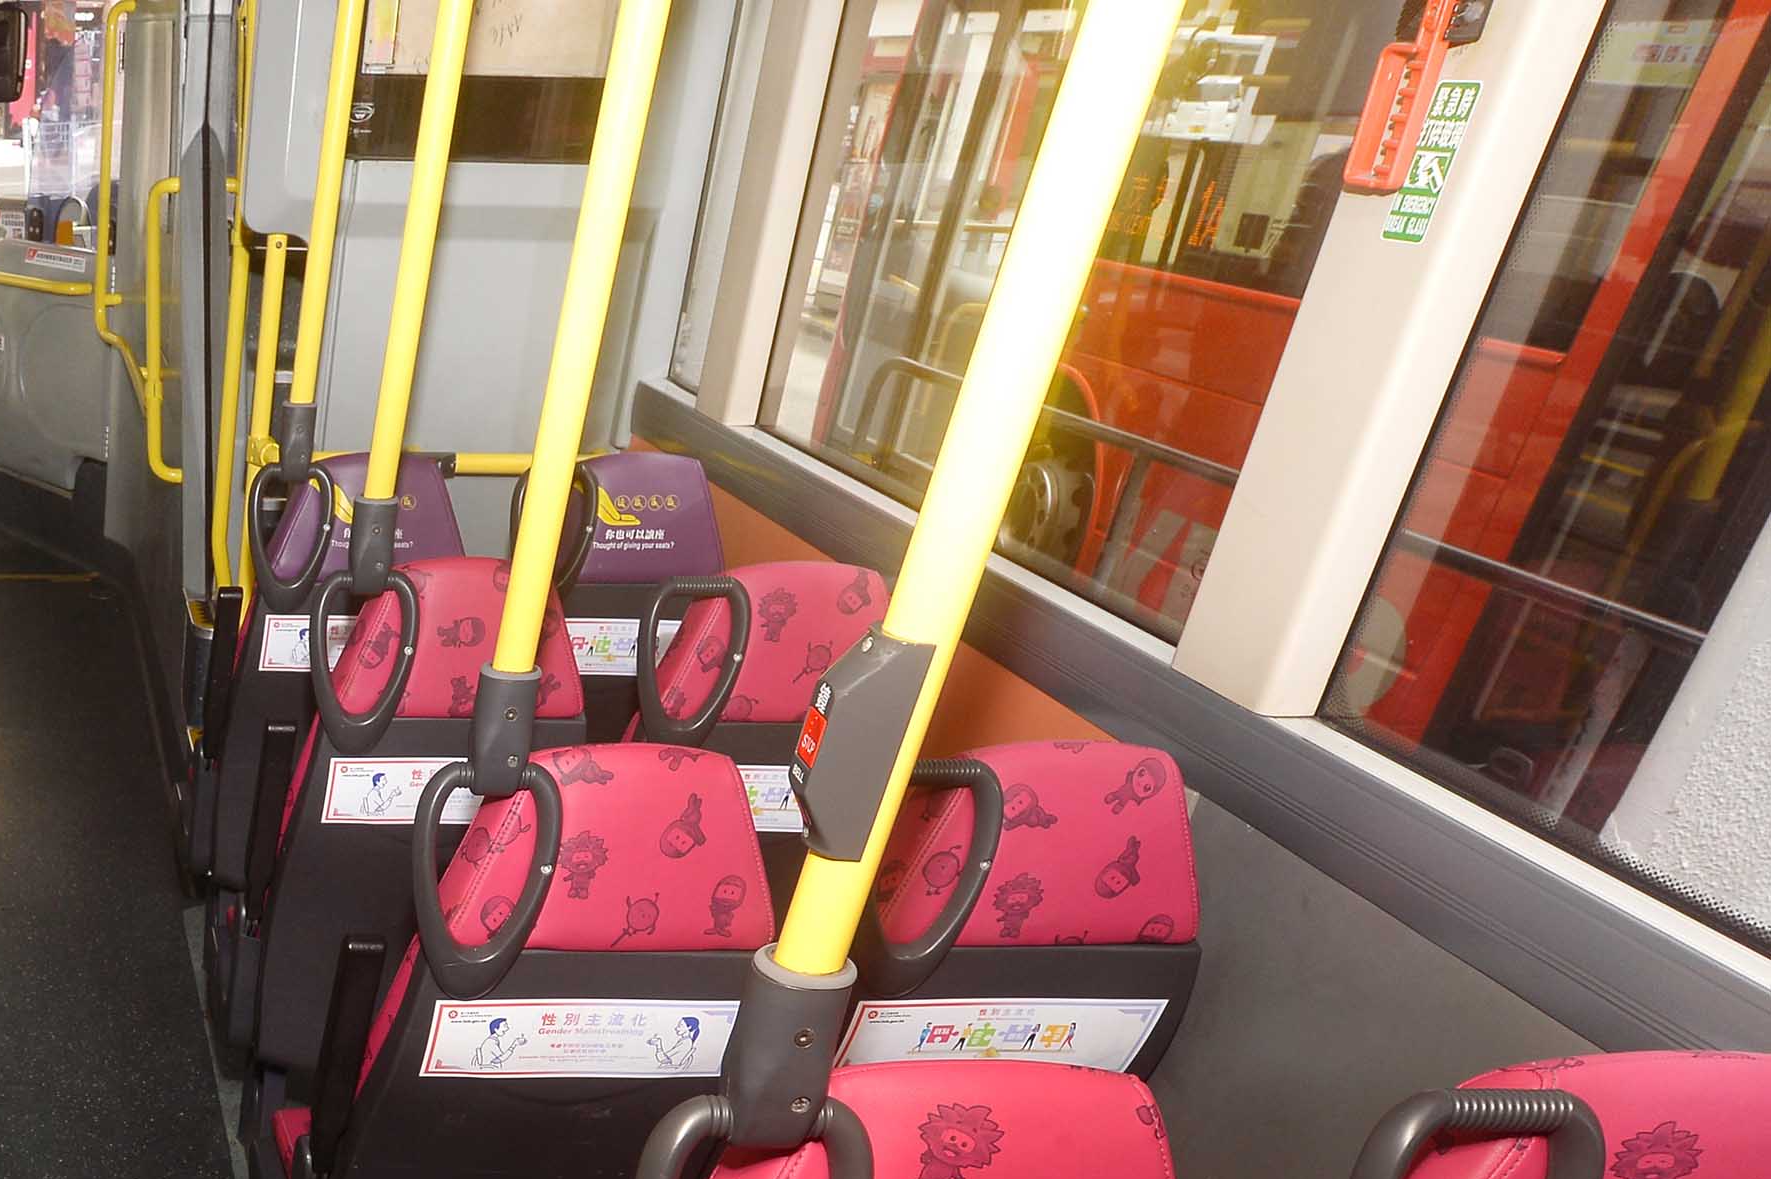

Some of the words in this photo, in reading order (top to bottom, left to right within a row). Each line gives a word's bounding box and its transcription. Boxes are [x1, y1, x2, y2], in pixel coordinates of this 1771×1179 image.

[593, 541, 616, 551] Thought
[624, 542, 641, 551] giving
[801, 734, 816, 753] STOP
[541, 1012, 647, 1027] 性別主流化
[538, 1027, 572, 1035] Gender
